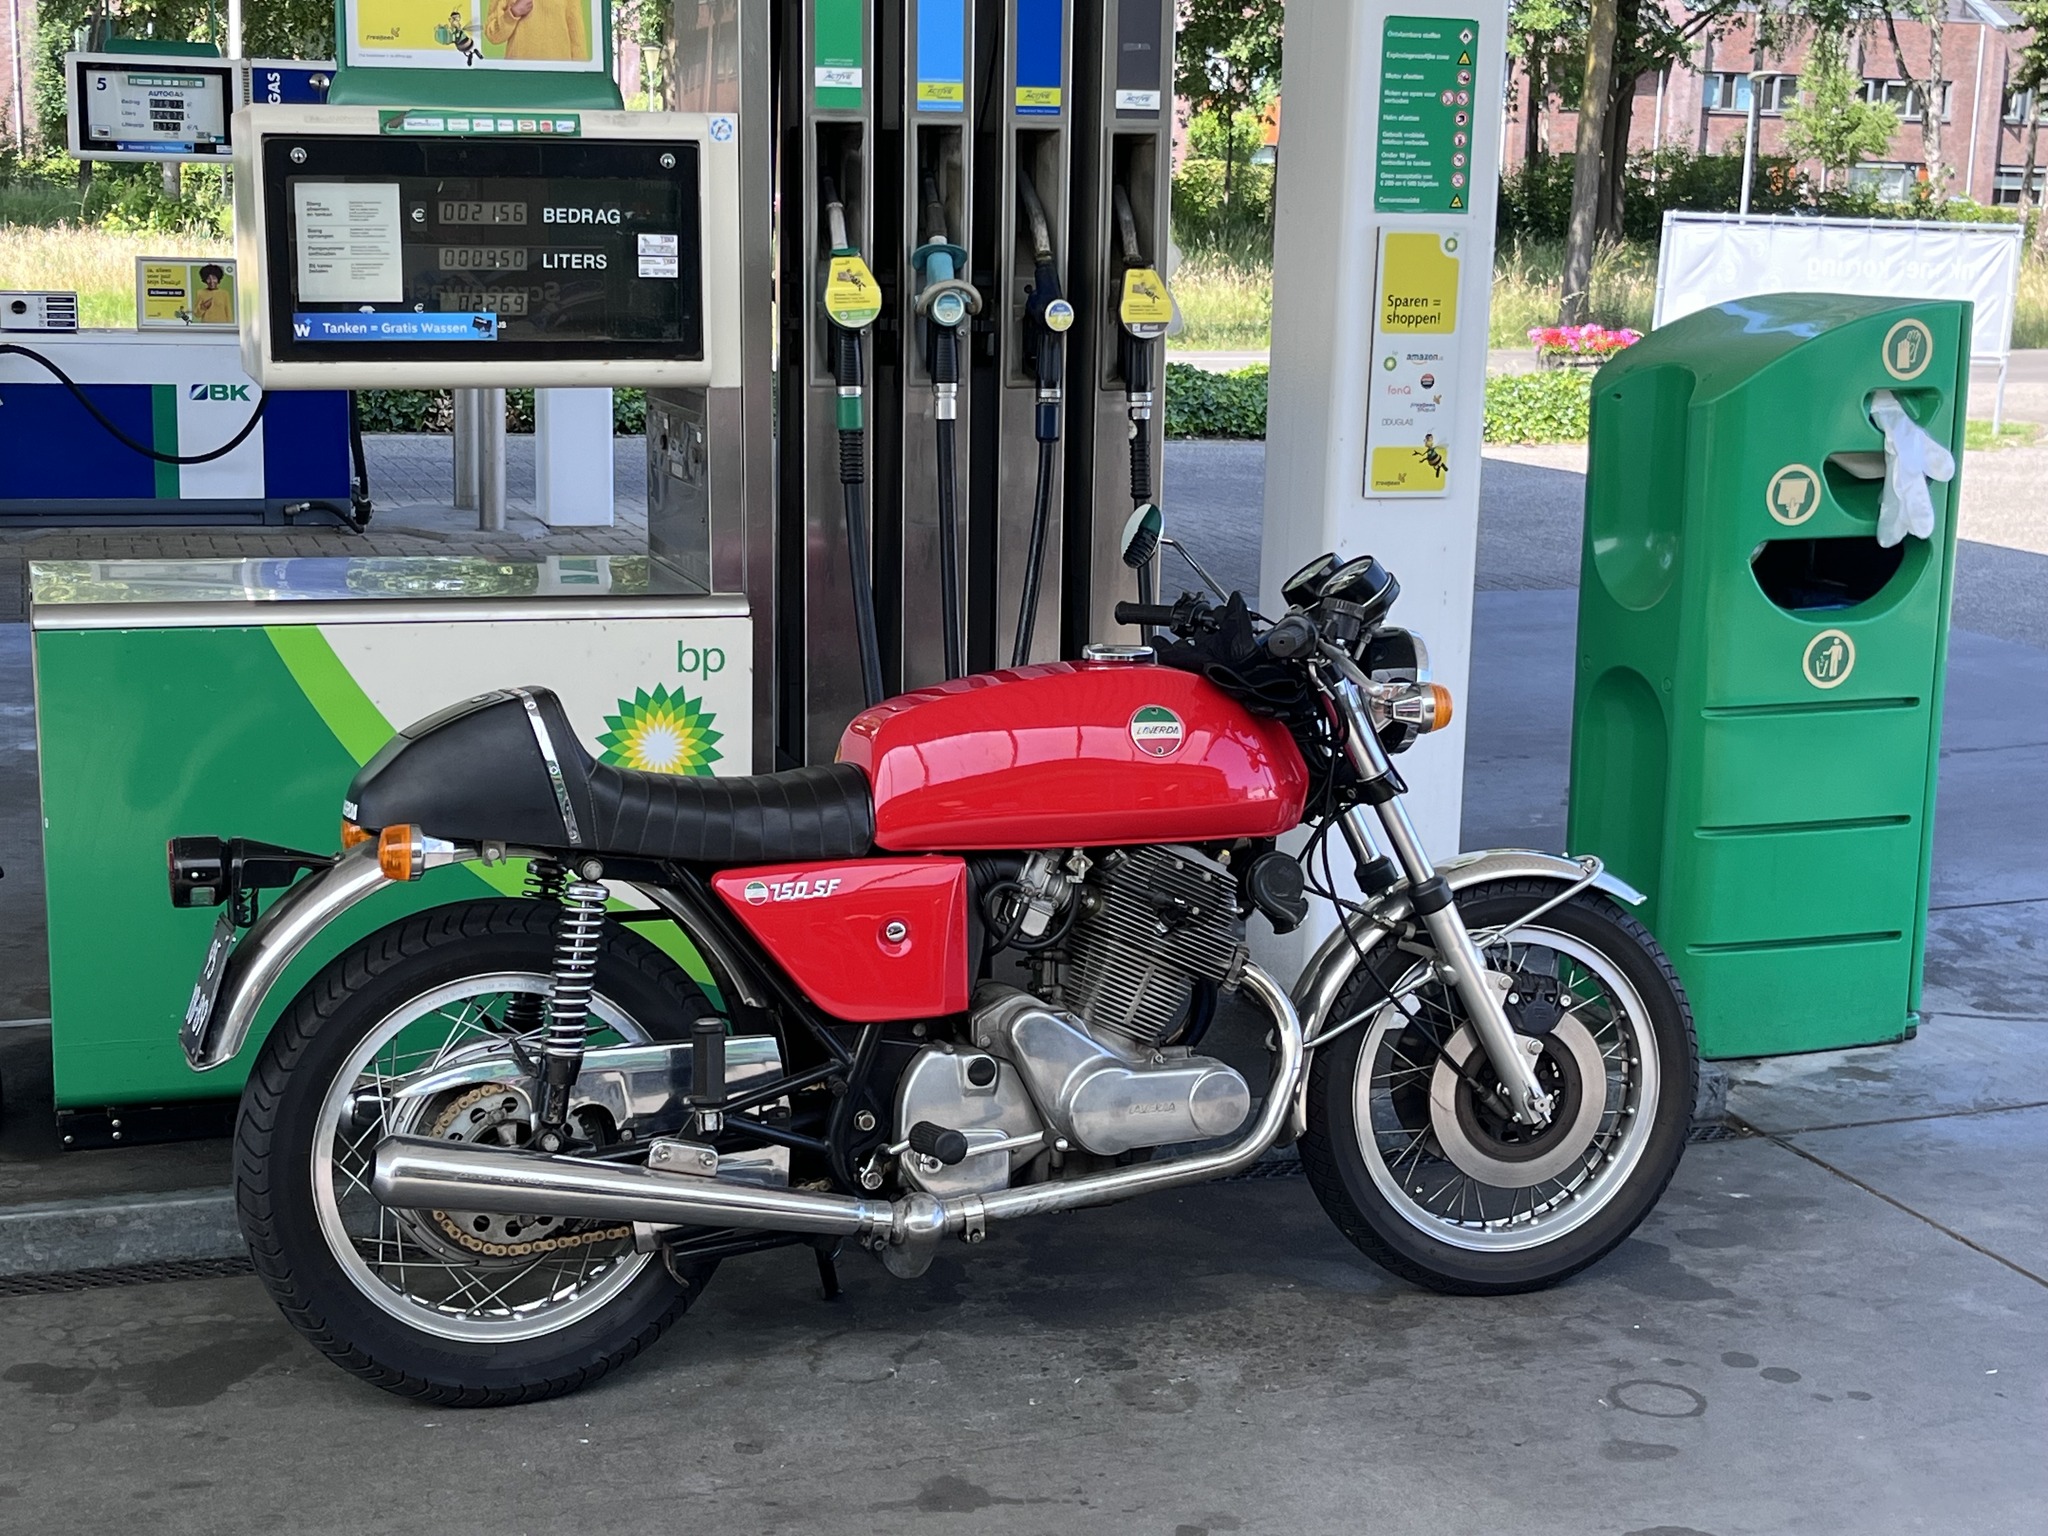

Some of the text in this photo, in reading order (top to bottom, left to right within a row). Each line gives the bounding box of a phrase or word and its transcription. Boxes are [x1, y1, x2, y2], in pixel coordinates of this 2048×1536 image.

[96, 77, 107, 91] 5
[267, 72, 281, 105] GAS
[411, 208, 425, 223] €
[543, 208, 621, 225] BEDRAG
[543, 253, 608, 270] LITERS
[1387, 294, 1428, 310] Sparen
[323, 322, 367, 334] Tanken
[381, 322, 418, 334] Gratis
[420, 322, 468, 334] Wassen
[1386, 312, 1441, 328] shoppen!
[209, 384, 251, 401] BK
[1388, 385, 1411, 395] fonQ
[678, 640, 725, 681] bp
[1136, 725, 1179, 735] LAVERDA
